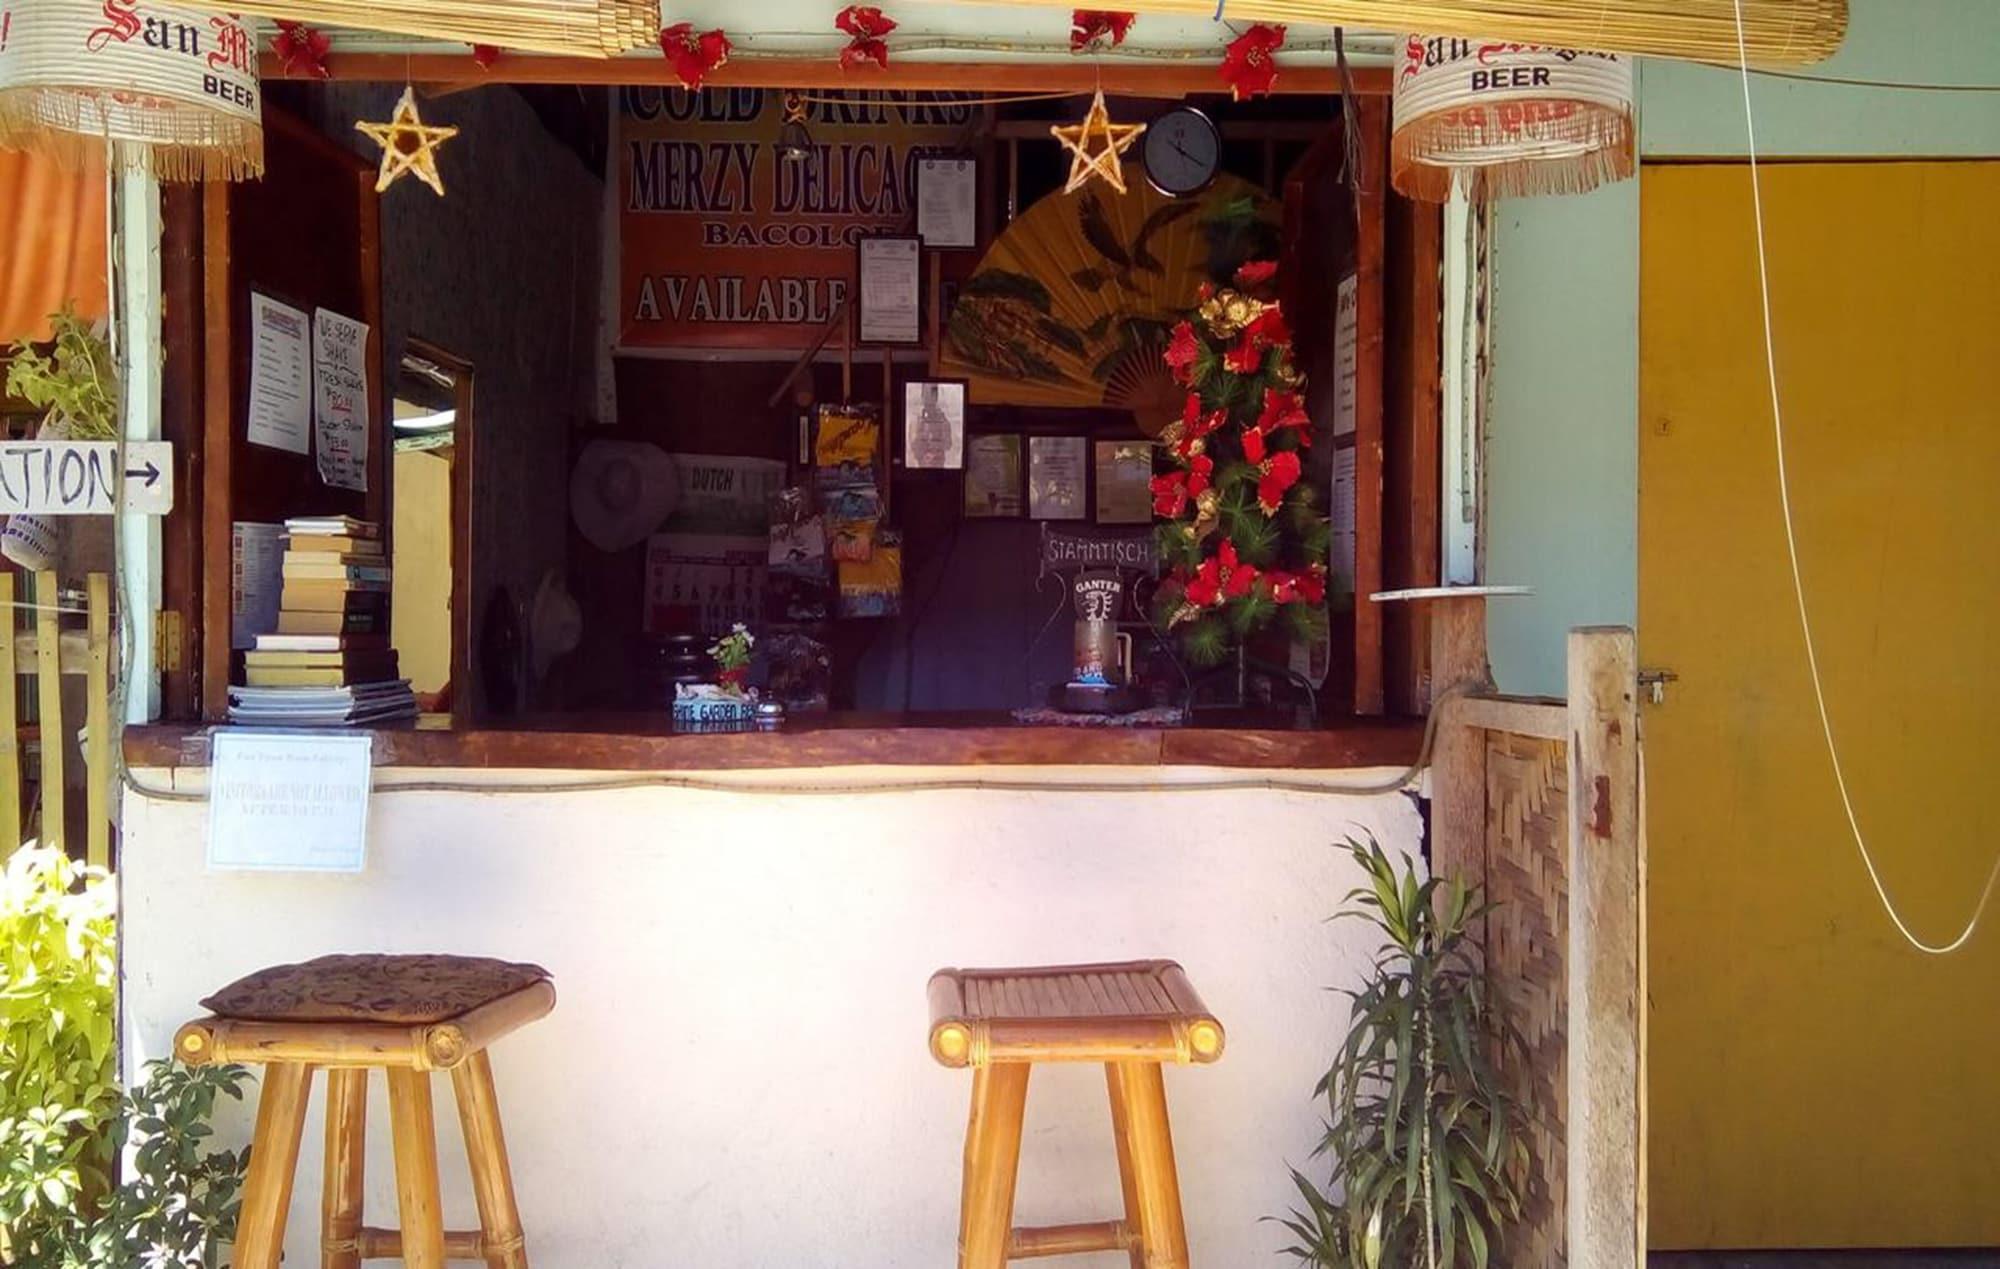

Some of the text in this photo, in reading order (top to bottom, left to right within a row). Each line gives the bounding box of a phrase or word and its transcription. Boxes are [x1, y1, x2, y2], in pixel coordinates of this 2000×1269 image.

[87, 0, 201, 57] San
[203, 75, 254, 110] BEER
[1471, 67, 1551, 91] BEER
[629, 141, 760, 214] MERZY
[634, 274, 847, 323] AVAILABLE
[691, 466, 735, 492] DUTCH
[1048, 536, 1150, 563] STAMMTISCH
[1075, 579, 1121, 594] GANTER
[699, 703, 738, 722] GARDEN
